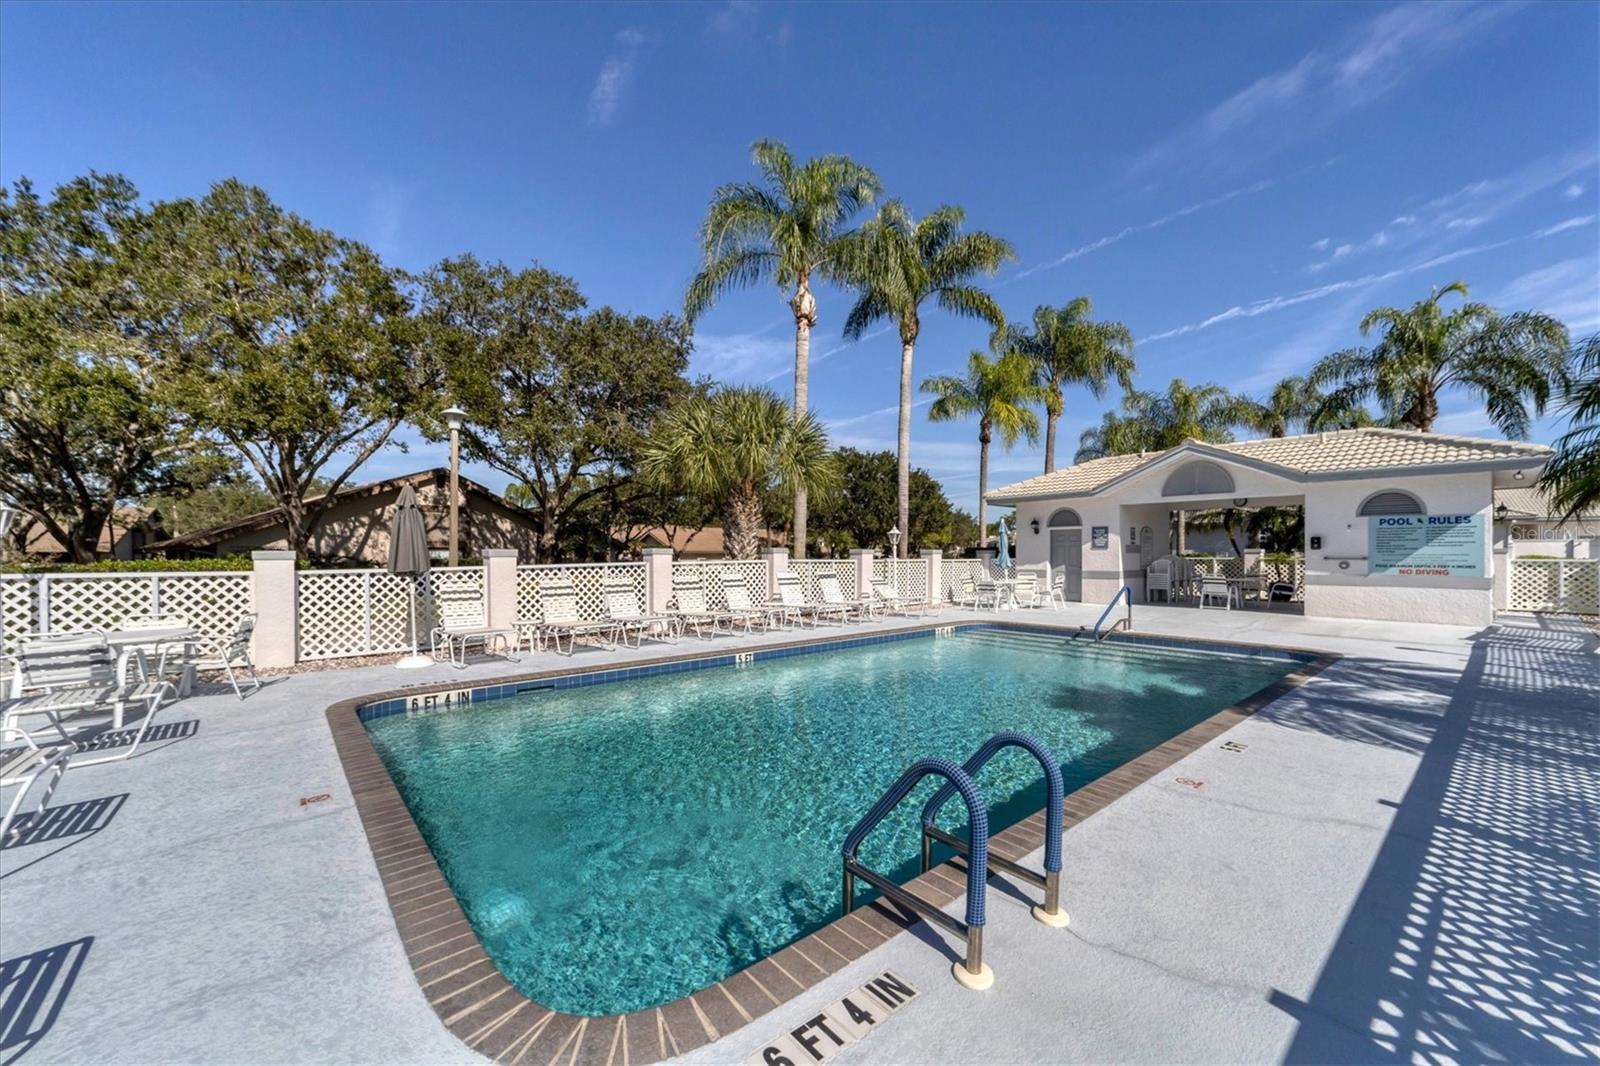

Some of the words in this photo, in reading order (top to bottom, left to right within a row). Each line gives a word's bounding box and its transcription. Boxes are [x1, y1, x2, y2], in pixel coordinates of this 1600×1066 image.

[1379, 518, 1413, 526] POOL
[1428, 515, 1472, 525] RULES
[411, 698, 419, 711] 6
[445, 693, 451, 707] 4
[457, 691, 470, 705] IN
[790, 1013, 845, 1061] FT
[841, 998, 876, 1026] 4
[865, 972, 916, 1009] IN
